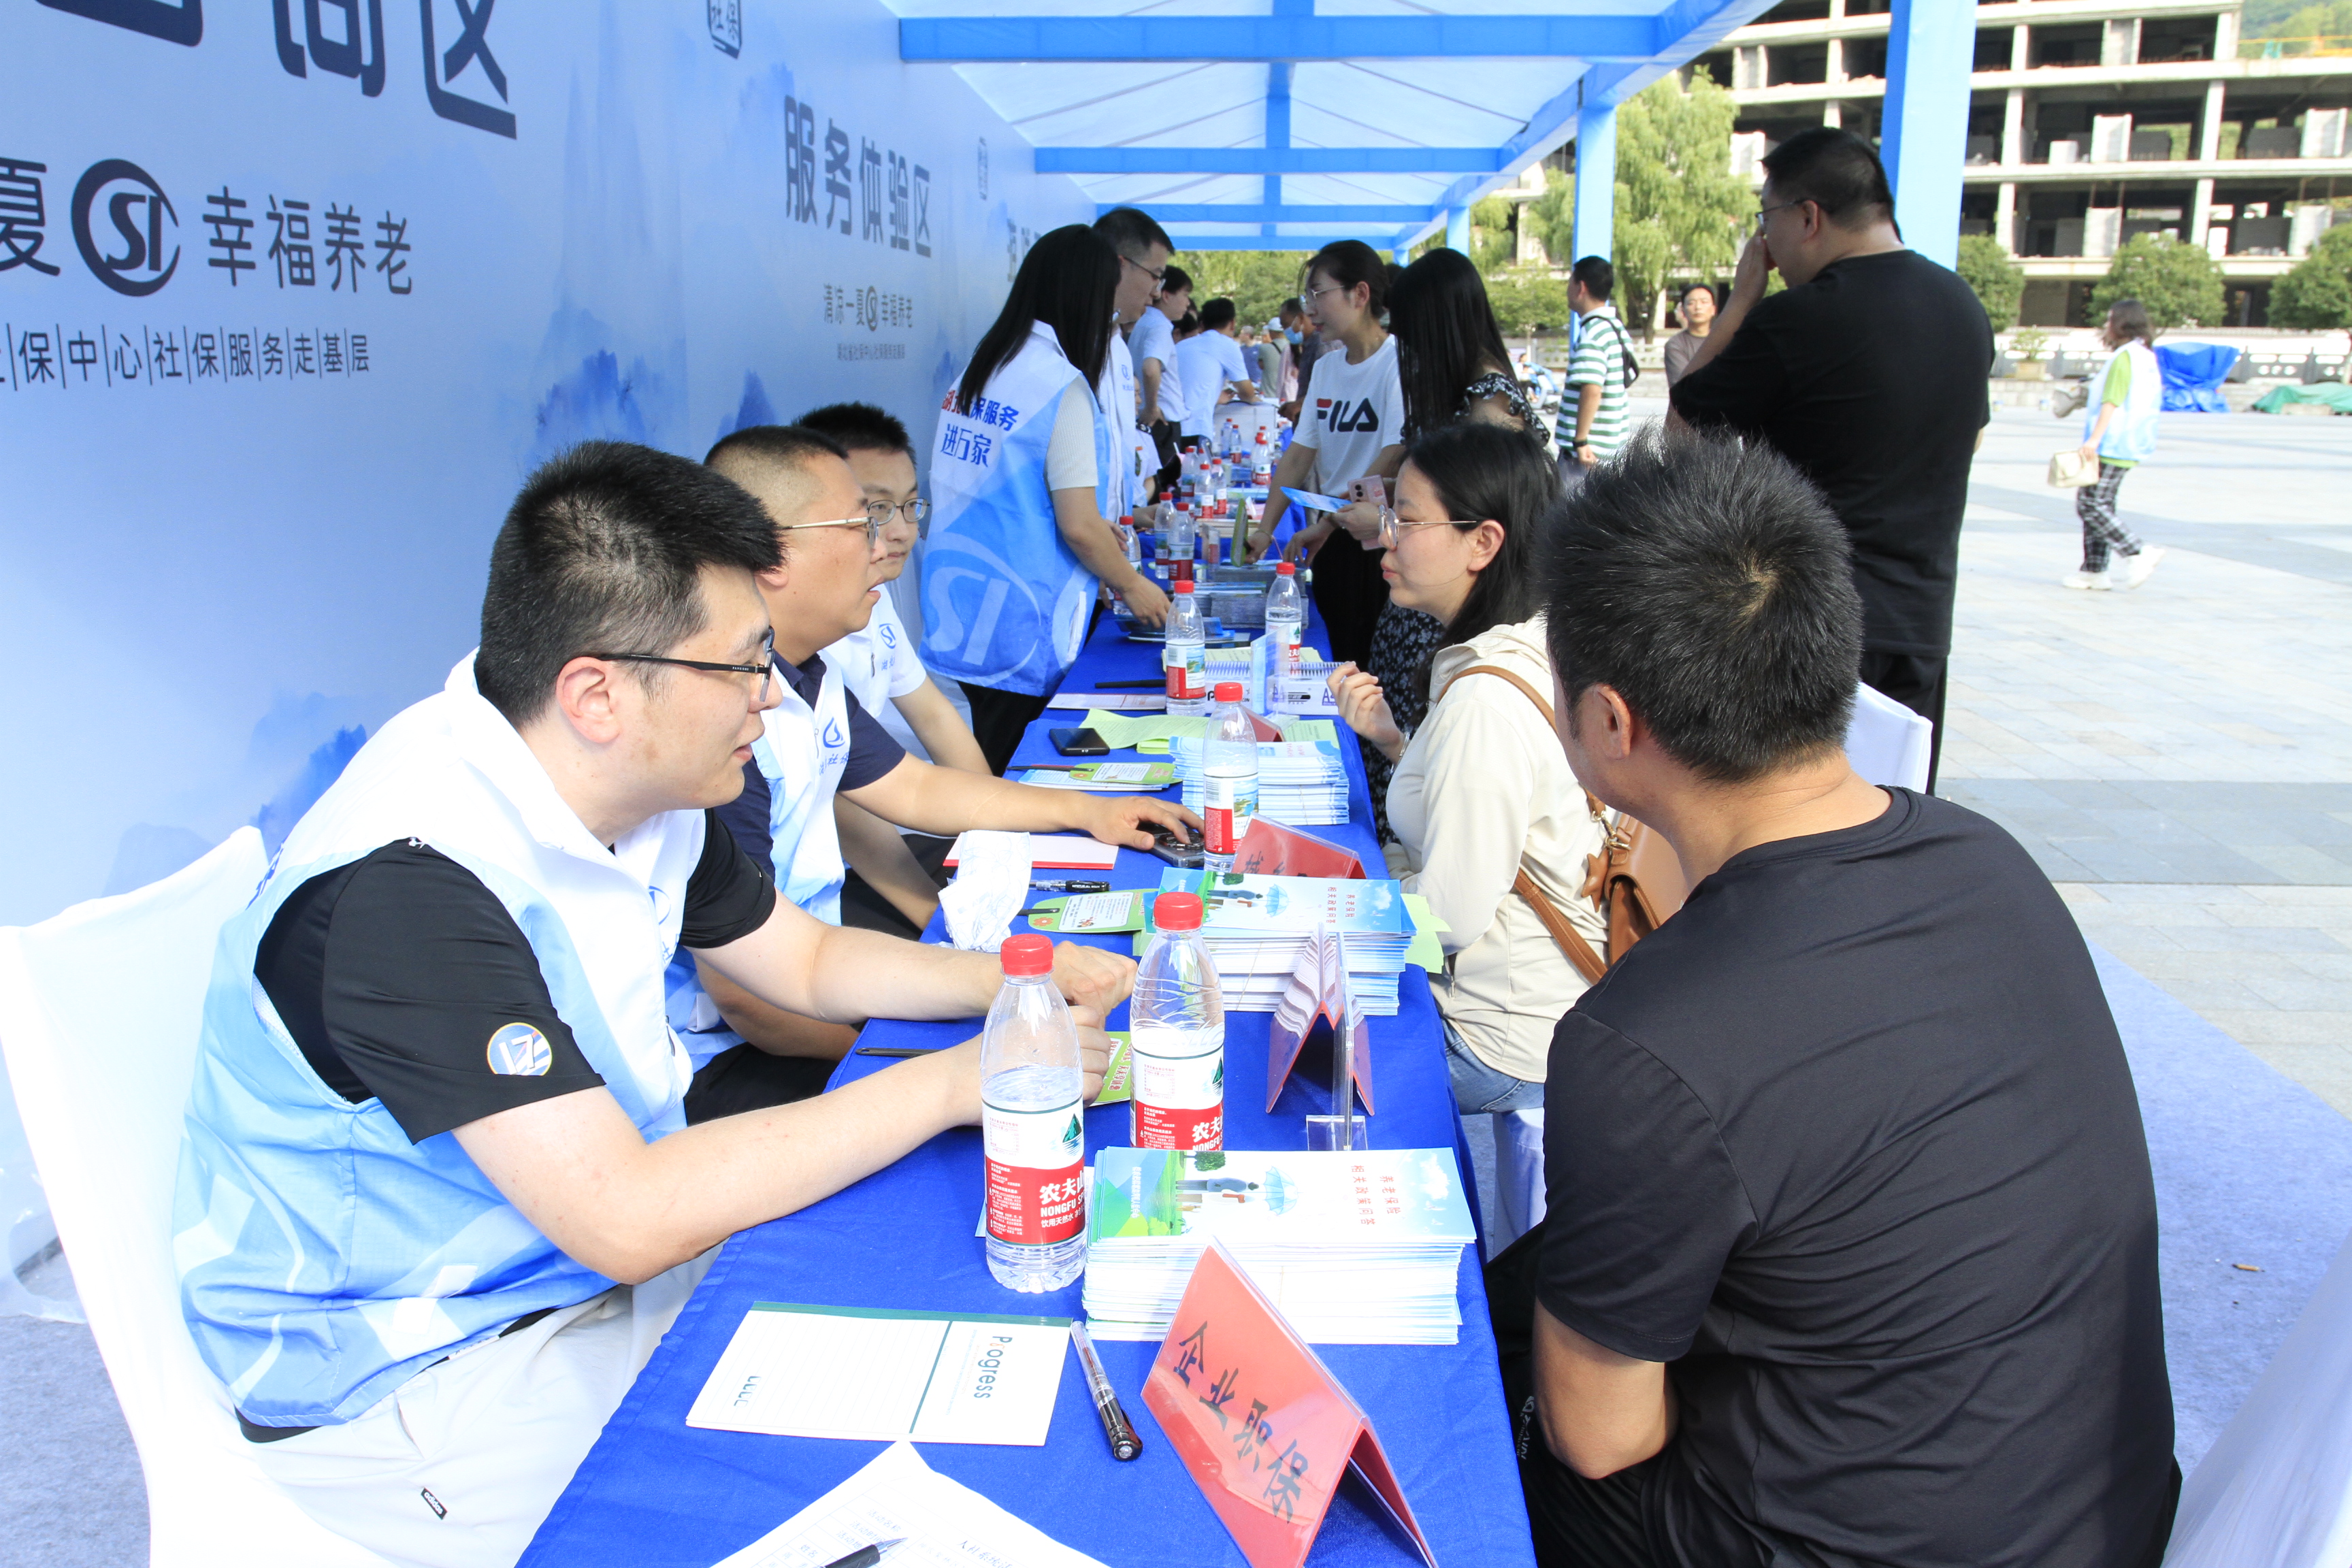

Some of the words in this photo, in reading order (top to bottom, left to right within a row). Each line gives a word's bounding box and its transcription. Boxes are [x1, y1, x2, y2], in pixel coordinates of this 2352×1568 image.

[784, 94, 931, 258] 服务体验区
[202, 185, 412, 295] 幸福养老
[0, 330, 370, 384] 保中心社保服务走基层
[1316, 397, 1379, 432] FILA
[940, 423, 992, 468] 进万家
[1345, 894, 1356, 918] 养老保险
[1041, 1198, 1077, 1218] NONGFU
[1351, 1165, 1375, 1225] 相关政策问答
[1379, 1175, 1401, 1214] 养老保险
[1041, 1212, 1074, 1228] 饮用天然水
[973, 1336, 1013, 1399] Progress
[1173, 1320, 1309, 1524] 企业职保
[423, 1492, 443, 1515] adidas
[866, 1508, 902, 1533] 活动名称
[798, 1544, 818, 1558] 姓名
[835, 1529, 864, 1550] 活动地
